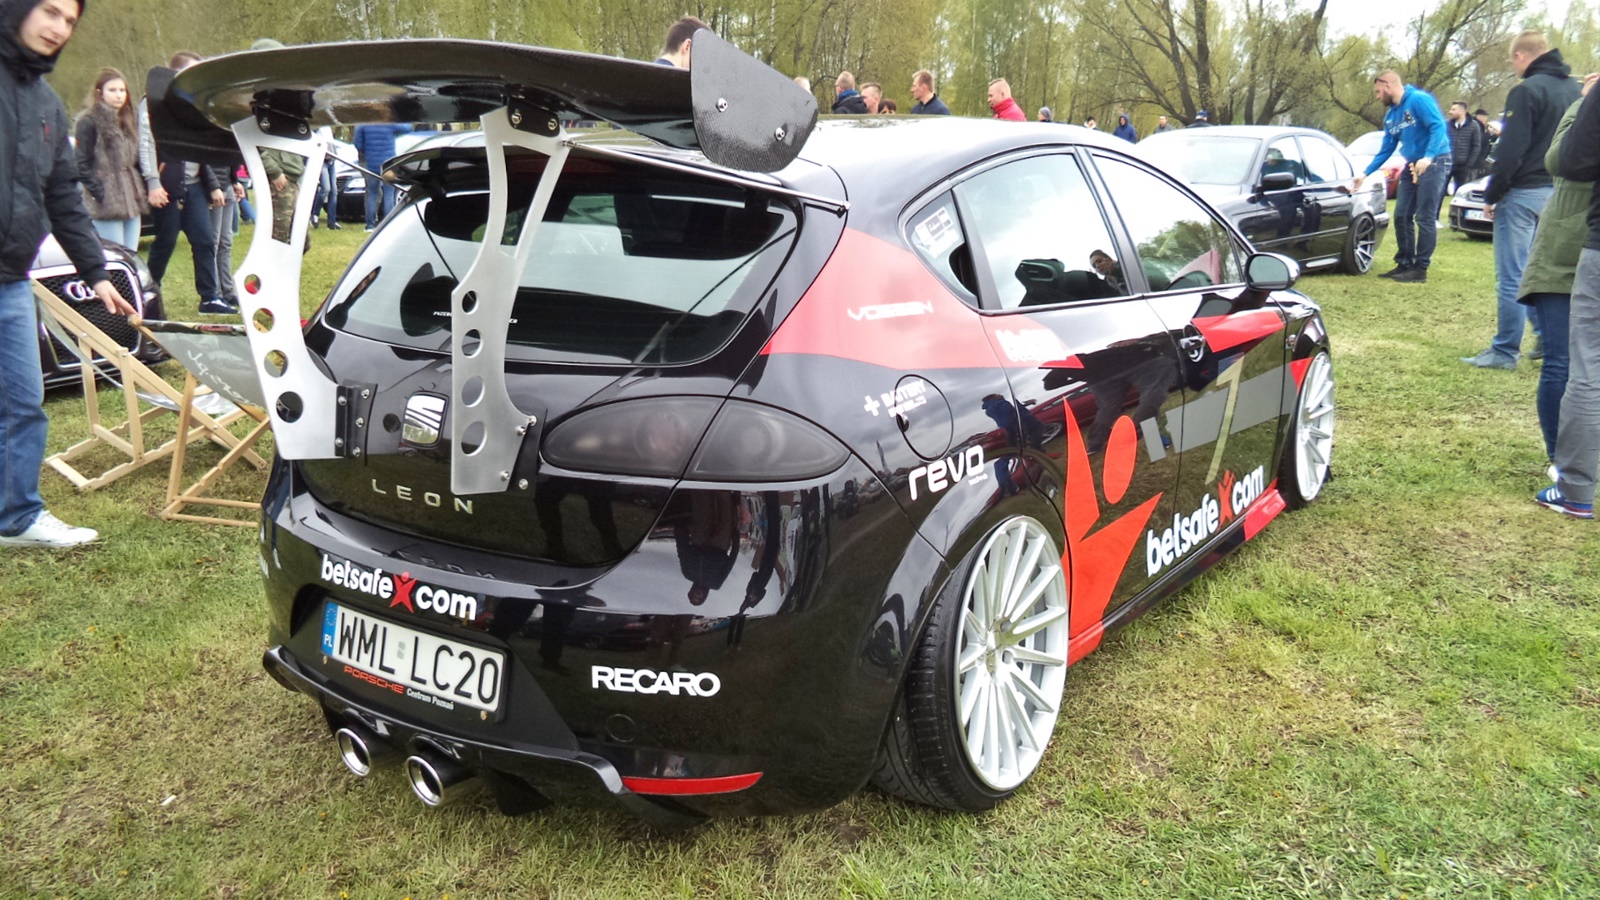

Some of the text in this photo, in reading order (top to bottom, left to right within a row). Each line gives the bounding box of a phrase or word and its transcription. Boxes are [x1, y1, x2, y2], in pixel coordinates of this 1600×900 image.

[909, 445, 984, 500] revo
[371, 478, 473, 514] LEON
[323, 633, 333, 648] PL
[339, 612, 499, 704] WML LC20
[344, 665, 404, 694] PORSCHE
[406, 688, 431, 703] Centrum
[591, 665, 721, 697] RECARO
